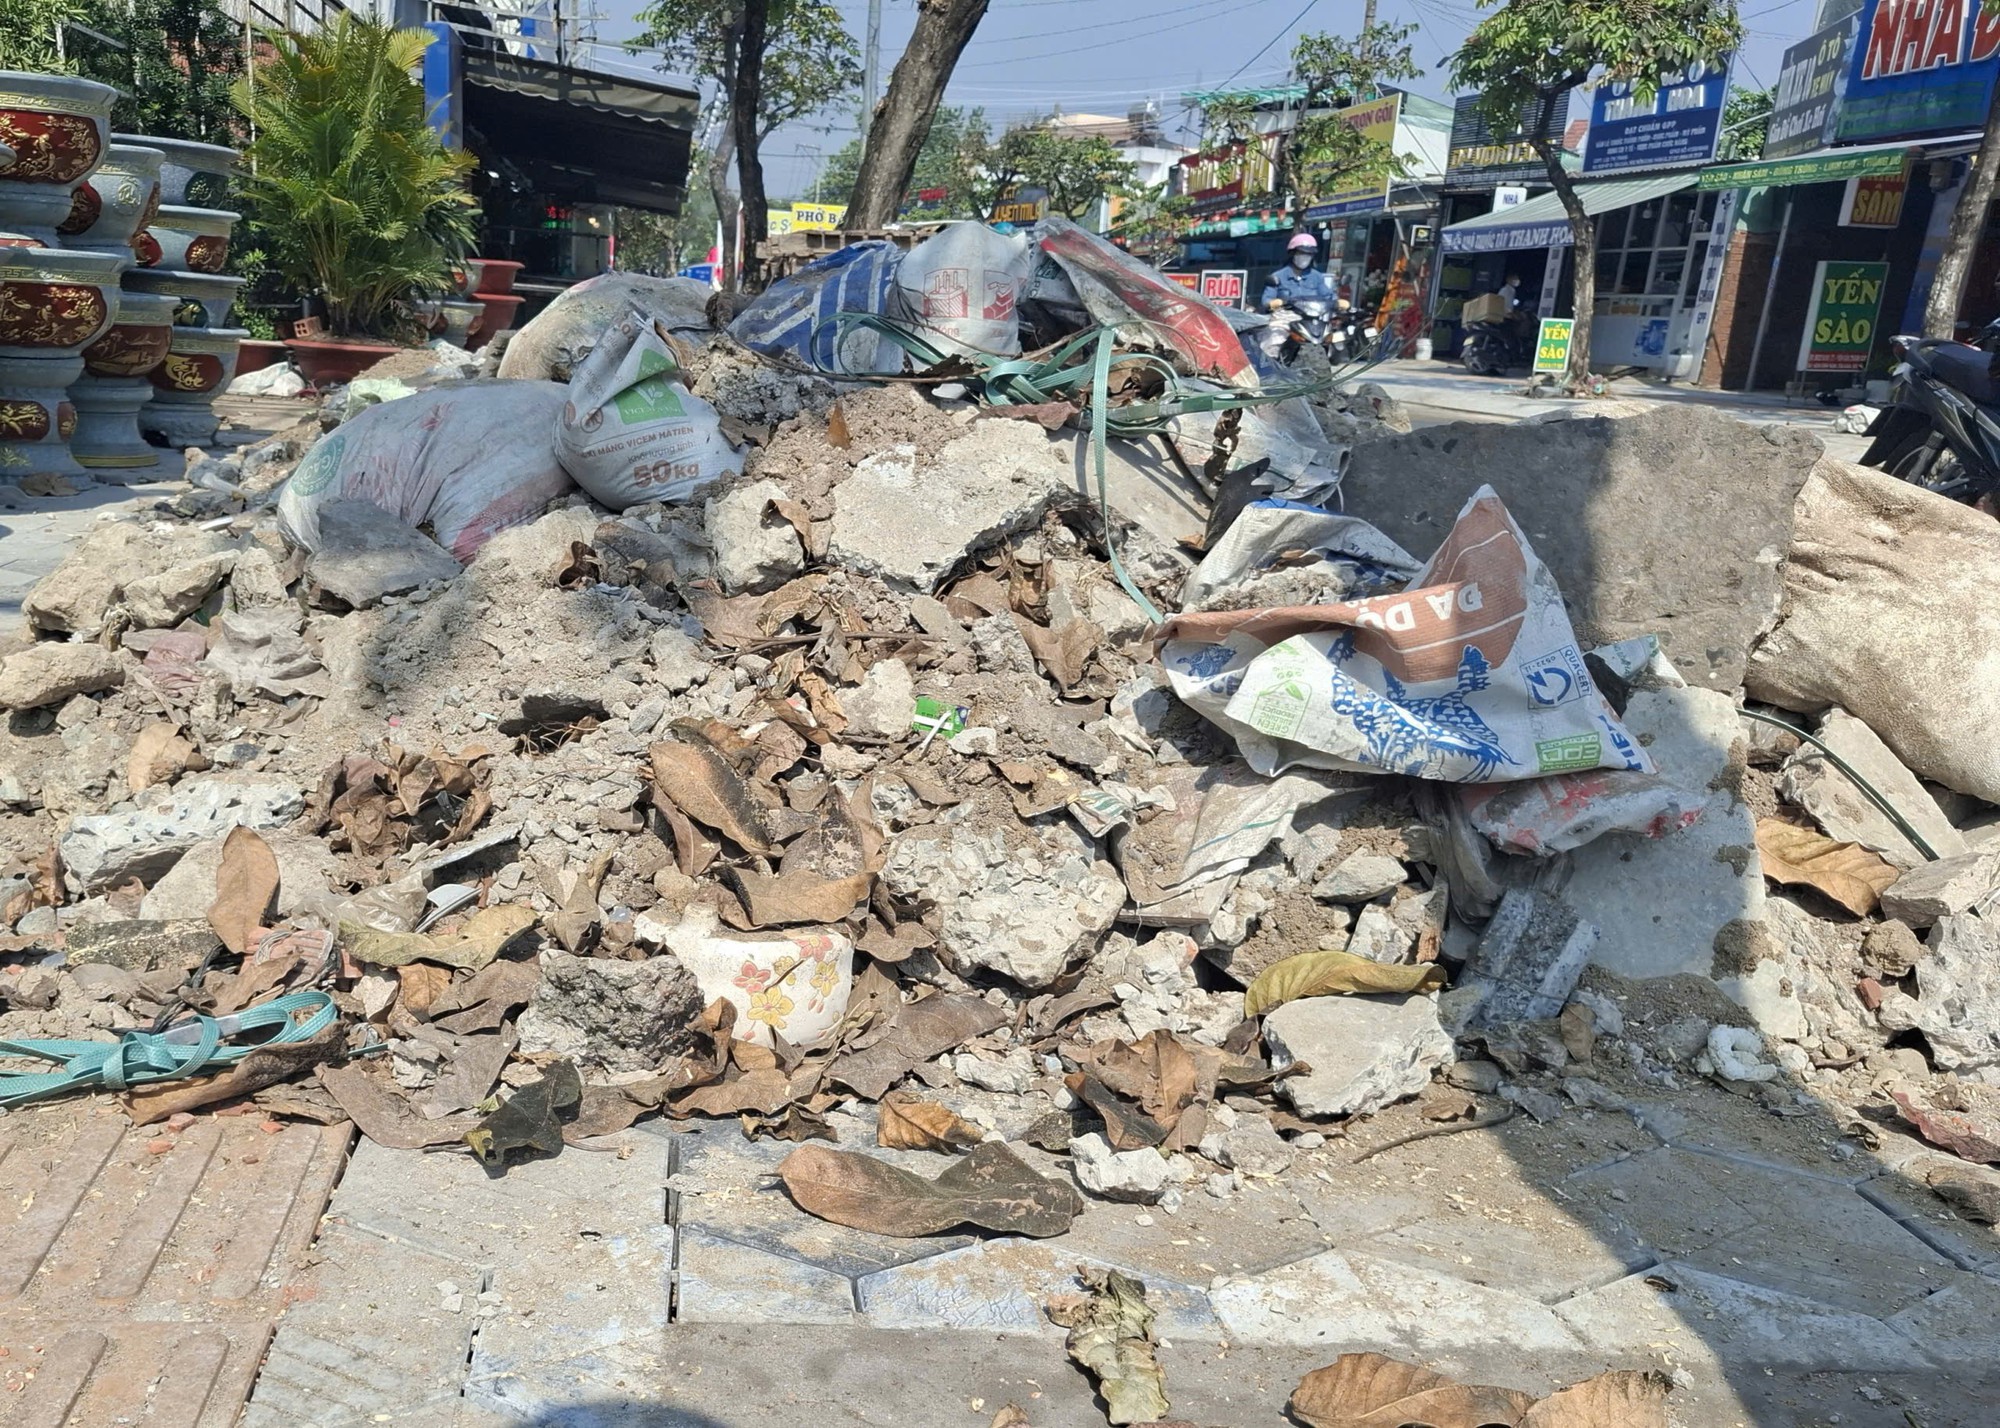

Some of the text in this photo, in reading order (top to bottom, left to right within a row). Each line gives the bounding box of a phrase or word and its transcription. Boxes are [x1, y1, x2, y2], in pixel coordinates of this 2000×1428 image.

[1503, 190, 1518, 205] NHÀ
[1853, 183, 1901, 223] SÂM
[796, 207, 825, 222] PHỞ
[1509, 227, 1550, 248] THANH
[1825, 268, 1881, 305] YẾN
[1544, 322, 1570, 340] YẾN
[1814, 312, 1871, 344] SÀO
[1539, 344, 1565, 359] SÀO
[626, 433, 657, 448] VICEM
[1564, 649, 1590, 693] QUACERT
[1262, 705, 1295, 719] PRODUCT
[1256, 718, 1290, 734] GREEN
